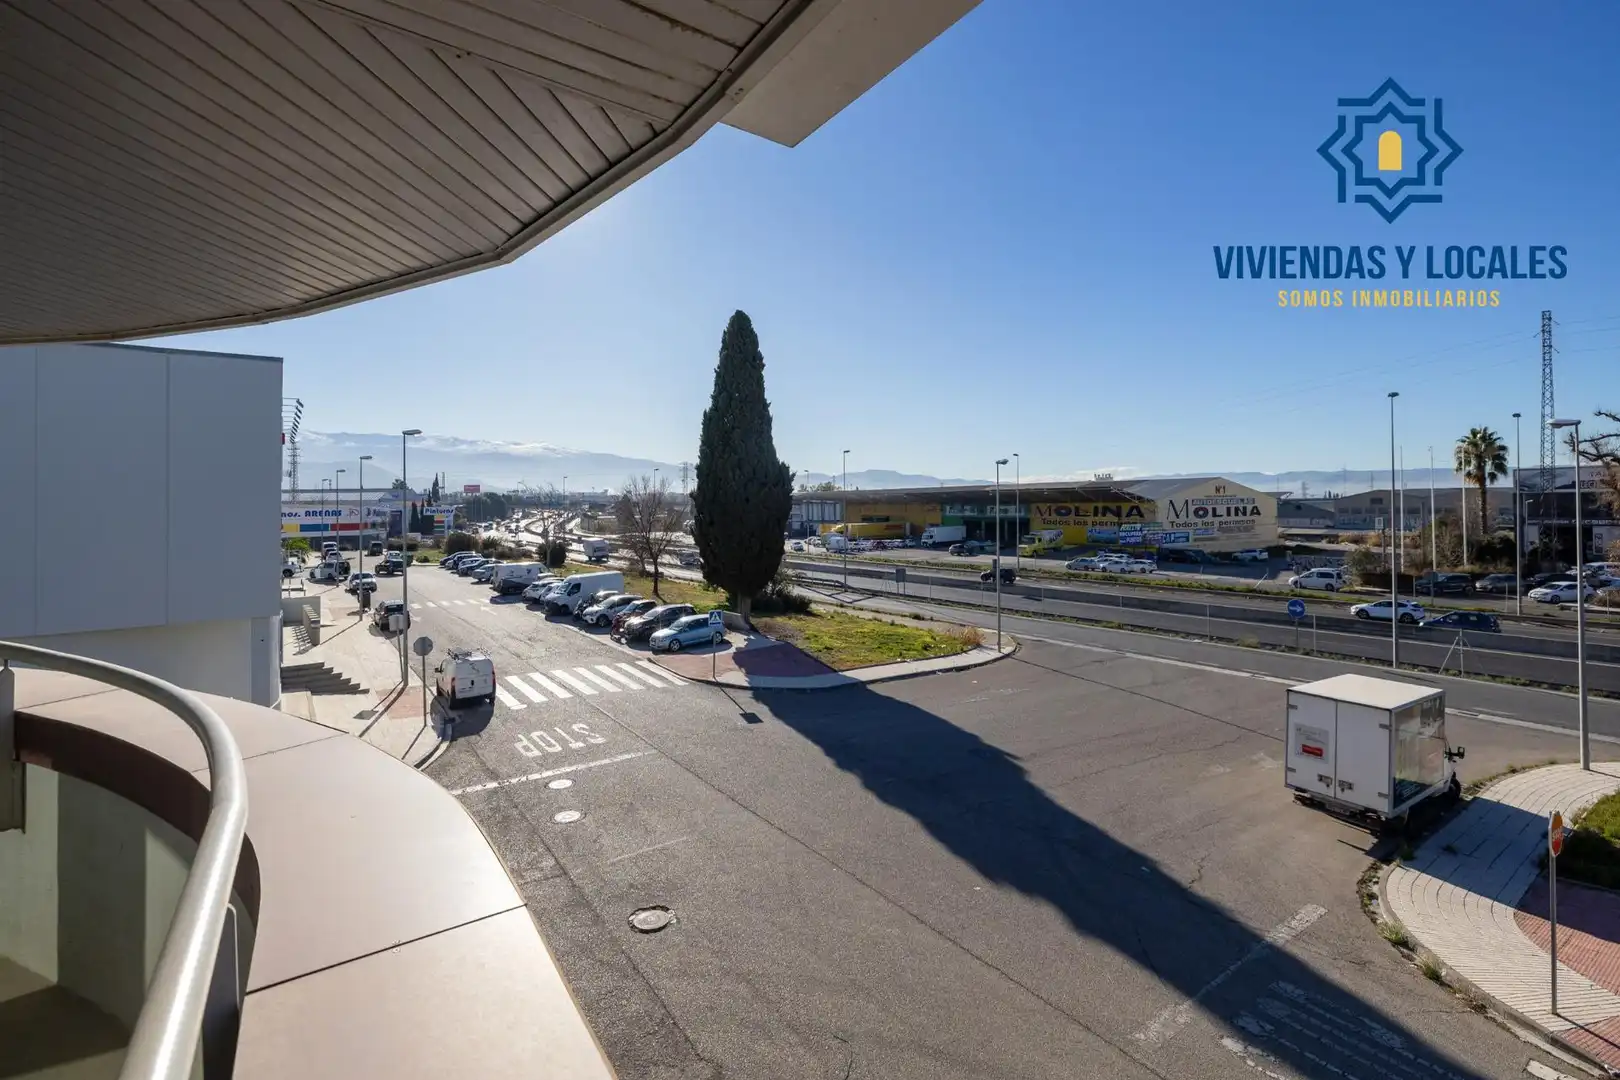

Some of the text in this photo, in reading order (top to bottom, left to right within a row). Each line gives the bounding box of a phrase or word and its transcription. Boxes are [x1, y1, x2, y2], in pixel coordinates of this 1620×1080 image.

[1035, 505, 1145, 518] MOLINA
[1166, 499, 1262, 520] MOLINA
[1041, 518, 1070, 526] Todos
[1169, 518, 1256, 528] Todos los permisos
[514, 723, 606, 757] STOP
